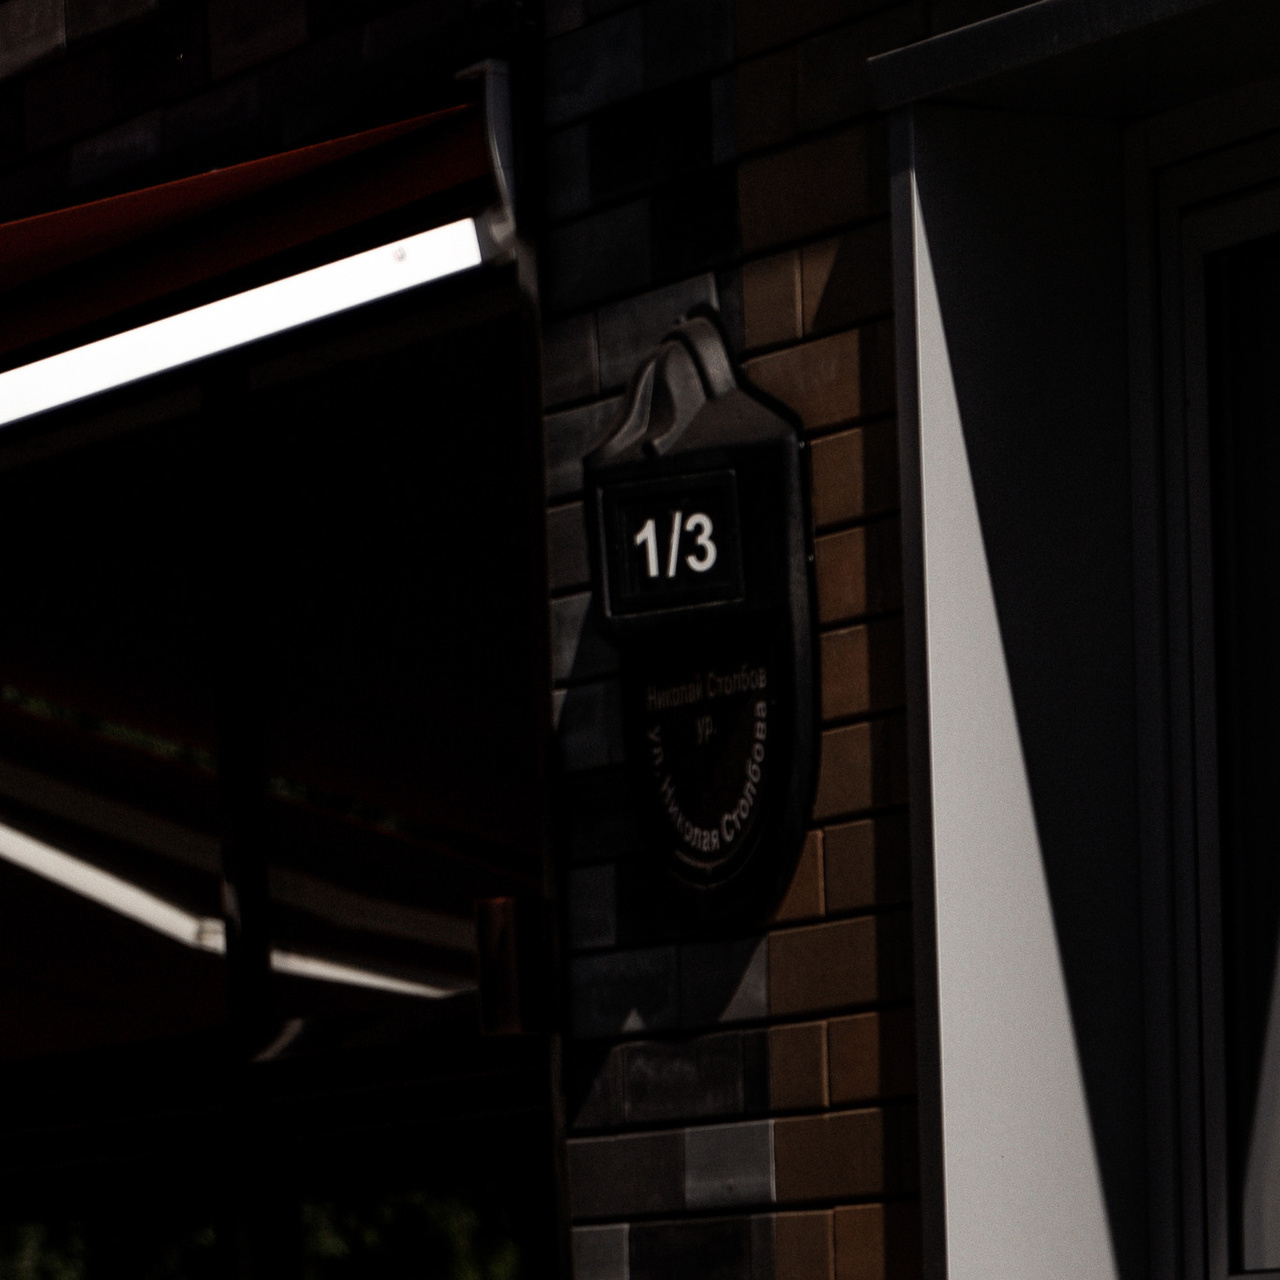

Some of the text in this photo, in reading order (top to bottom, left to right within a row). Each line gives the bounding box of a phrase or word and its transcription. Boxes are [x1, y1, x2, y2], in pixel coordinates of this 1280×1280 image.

[634, 508, 718, 579] 1/3
[645, 664, 767, 712] Николай Столбов
[659, 772, 720, 852] Николая
[720, 700, 768, 843] Столбова
